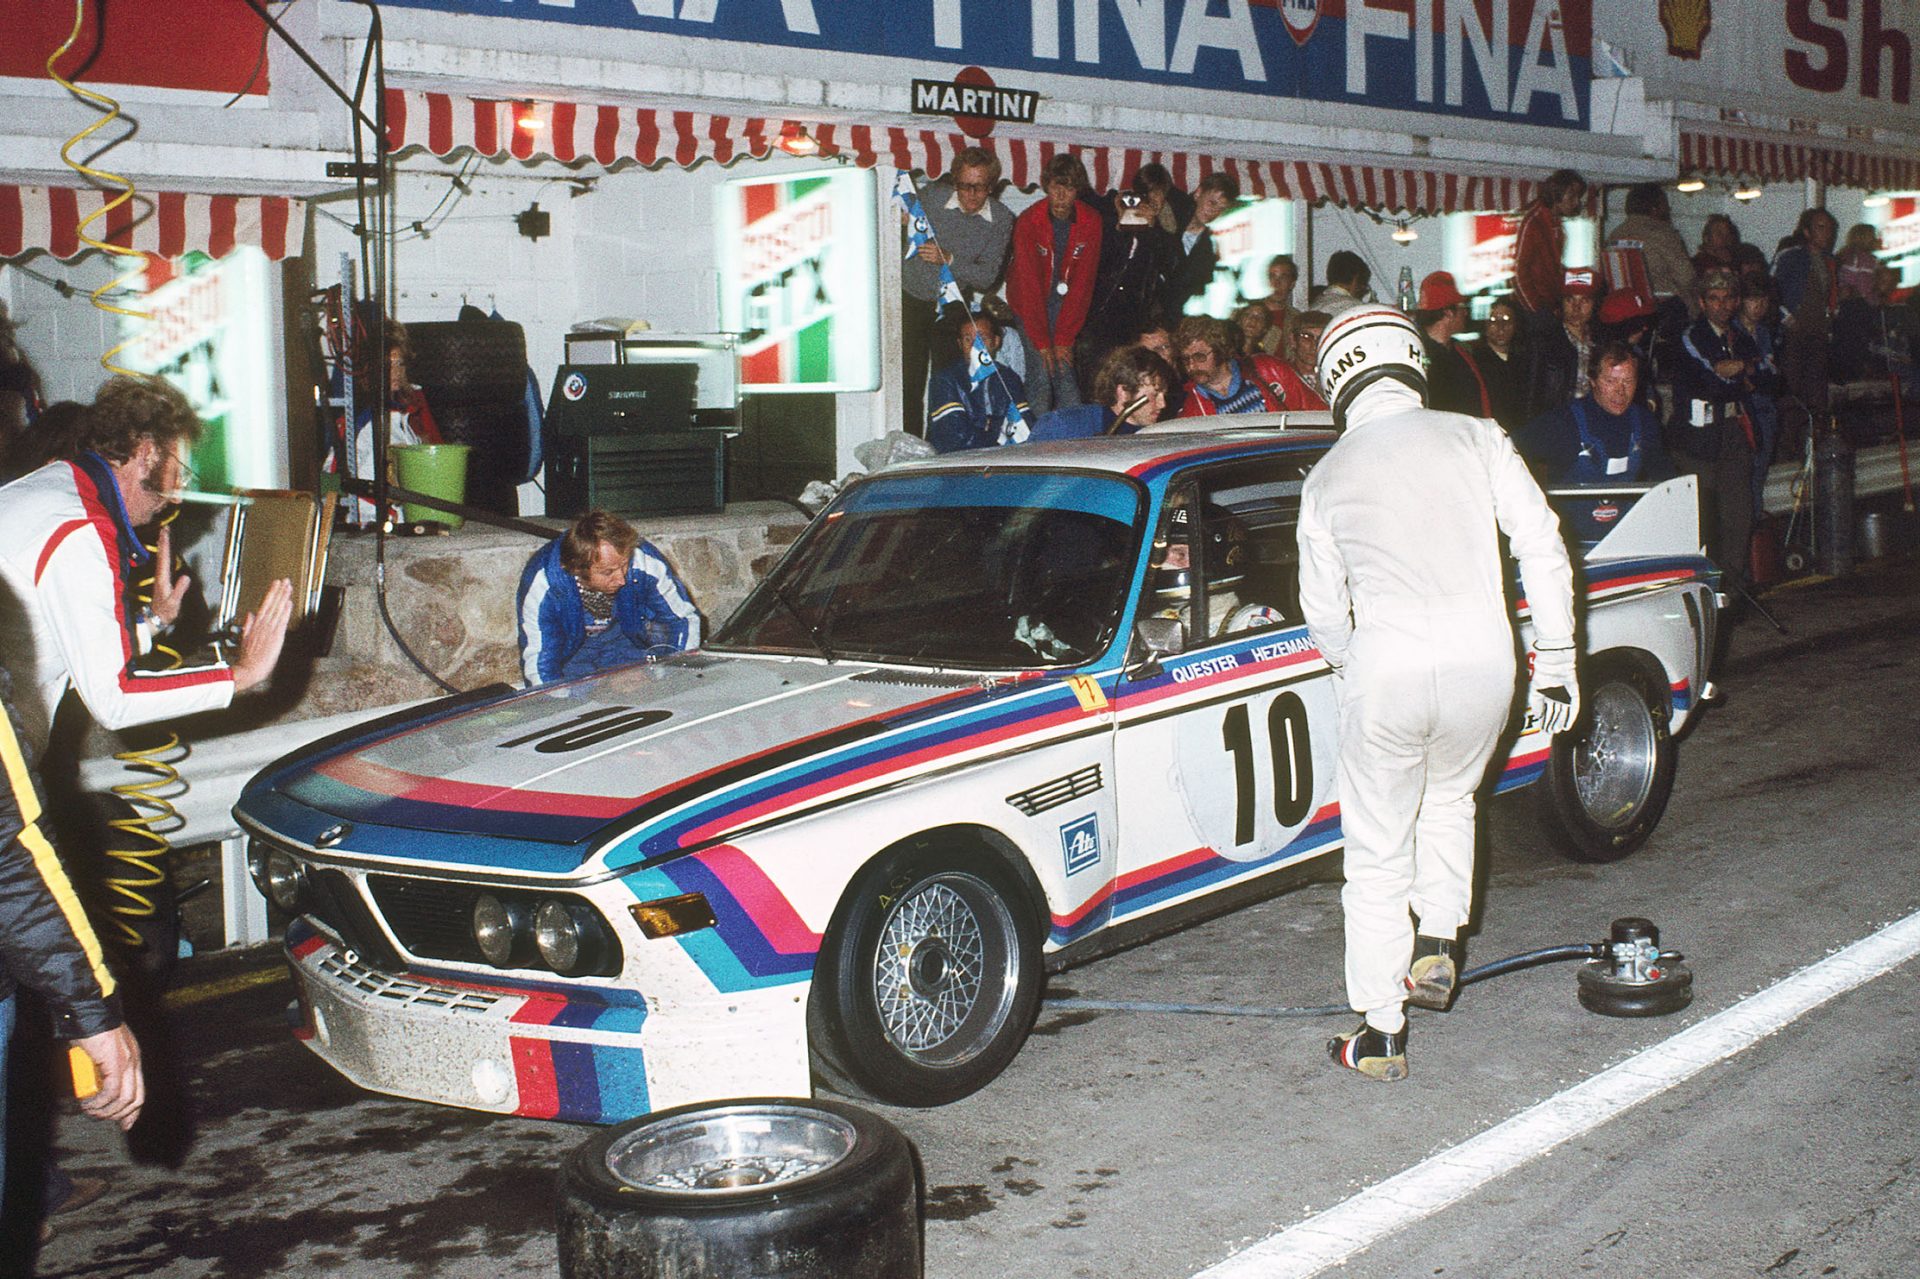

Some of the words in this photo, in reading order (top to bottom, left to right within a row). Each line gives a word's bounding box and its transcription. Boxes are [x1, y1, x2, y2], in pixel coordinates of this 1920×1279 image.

[1345, 0, 1580, 121] FINA
[917, 83, 1032, 119] MARTINI
[1171, 653, 1240, 684] QUESTER
[1250, 635, 1316, 663] HEZEMAN
[495, 705, 674, 754] 10
[1222, 690, 1314, 847] 10
